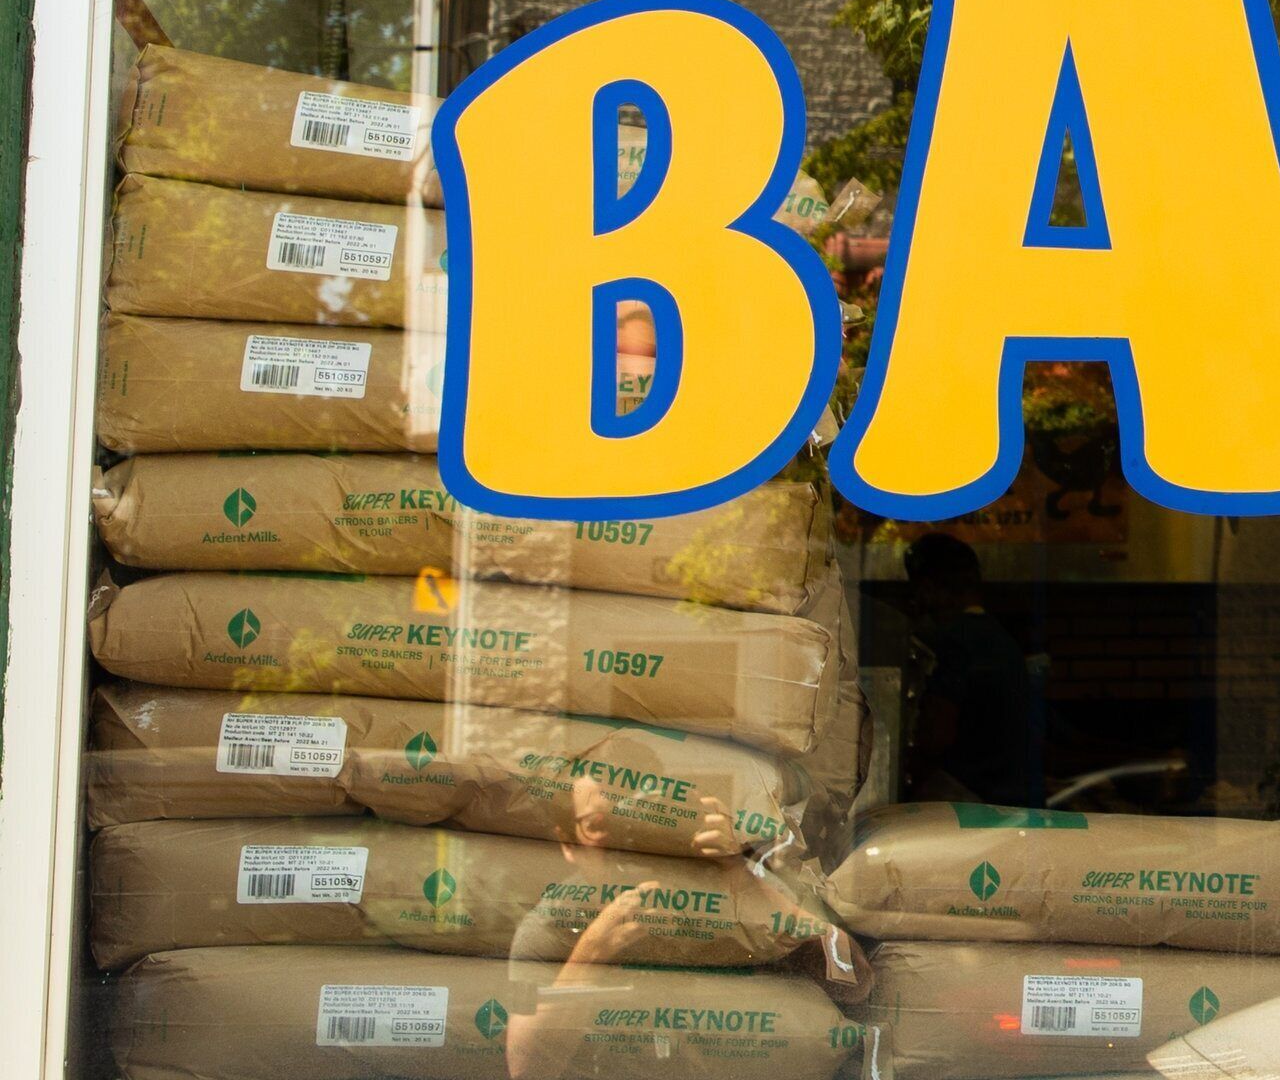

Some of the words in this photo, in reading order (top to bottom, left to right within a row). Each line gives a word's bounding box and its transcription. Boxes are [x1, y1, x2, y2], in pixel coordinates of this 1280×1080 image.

[367, 132, 412, 145] 5510597
[786, 193, 829, 221] 105
[343, 252, 388, 264] 5510597
[318, 371, 362, 383] 5510597
[342, 492, 396, 511] SUPER
[334, 516, 374, 527] STRONG
[377, 516, 418, 526] BAKERS
[359, 528, 392, 537] FLOUR
[505, 523, 534, 535] POUR
[574, 520, 654, 546] 10597
[202, 532, 246, 544] Ardent
[347, 623, 403, 642] SUPER
[406, 623, 532, 653] KEYNOTE
[204, 652, 247, 665] Ardent
[336, 646, 378, 658] STRONG
[381, 649, 423, 661] BAKERS
[440, 653, 475, 665] FARINE
[479, 655, 512, 667] FORTE
[515, 657, 543, 668] POUR
[361, 660, 395, 671] FLOUR
[583, 648, 664, 678] 10597
[293, 751, 338, 761] 5510597
[381, 772, 424, 785] Ardent
[570, 757, 690, 803] KEYNOTE
[525, 785, 554, 801] FLOUR
[600, 790, 634, 806] FARINE
[636, 798, 669, 814] FORTE
[670, 805, 698, 821] POUR
[611, 805, 678, 828] BOULANGERS
[734, 808, 787, 841] 105
[314, 878, 359, 888] 5510597
[1082, 871, 1135, 889] SUPER
[1139, 870, 1255, 896] KEYNOTE
[541, 883, 597, 903] SUPER
[600, 883, 722, 914] KEYNOTE
[1072, 894, 1113, 905] STRONG
[1115, 896, 1155, 906] BAKERS
[1170, 898, 1204, 908] FARINE
[1207, 899, 1238, 910] FORTE
[1240, 901, 1267, 912] POUR
[1096, 906, 1129, 917] FLOUR
[1185, 909, 1250, 921] BOULANGERS
[633, 913, 668, 925] FARINE
[671, 916, 704, 928] FORTE
[705, 919, 733, 930] POUR
[648, 926, 715, 941] BOULANGERS
[593, 1008, 650, 1027] SUPER
[654, 1007, 776, 1033] KEYNOTE
[1094, 1011, 1137, 1021] 5510597
[395, 1022, 440, 1031] 5510597
[584, 1033, 626, 1043] STRONG
[686, 1035, 721, 1046] FARINE
[726, 1037, 757, 1048] FORTE
[761, 1039, 789, 1049] POUR
